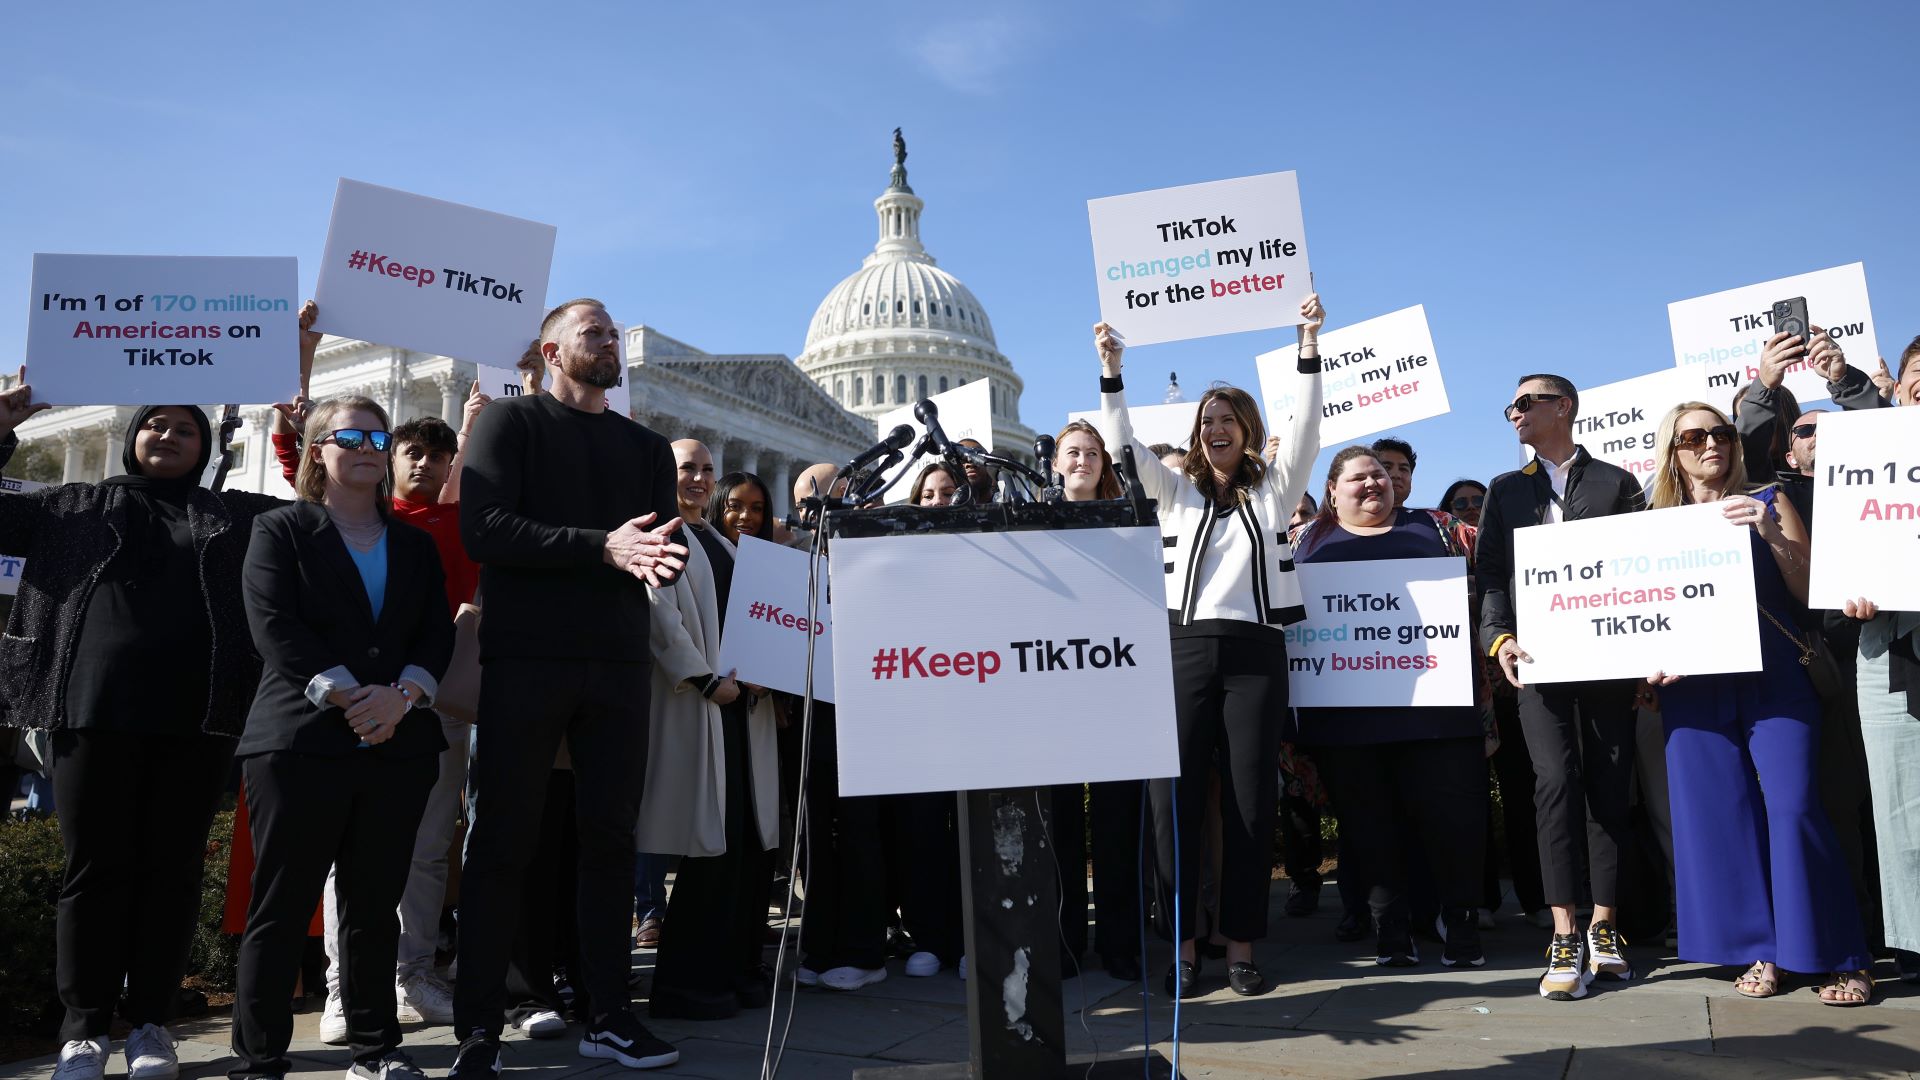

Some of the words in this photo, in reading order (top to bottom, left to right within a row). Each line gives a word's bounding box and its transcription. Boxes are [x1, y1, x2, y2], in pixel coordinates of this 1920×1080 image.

[1157, 215, 1237, 242] TikTok
[1107, 249, 1211, 281] changed
[1217, 247, 1253, 267] my
[1260, 239, 1297, 260] life
[348, 250, 435, 287] #Keep
[443, 268, 524, 303] TikTok
[43, 293, 86, 311] I'm
[94, 295, 106, 311] 1
[114, 294, 144, 311] of
[151, 295, 196, 312] 170
[204, 294, 289, 312] million
[1125, 290, 1160, 309] for
[1165, 284, 1205, 303] the
[1210, 273, 1285, 297] better
[73, 321, 221, 338] Americans
[228, 325, 261, 338] on
[1730, 310, 1774, 332] TikT
[124, 348, 214, 366] TikTok
[1684, 339, 1757, 365] helped
[1274, 372, 1356, 411] chged
[1361, 365, 1391, 383] my
[1396, 355, 1428, 373] life
[1708, 371, 1740, 388] my
[1322, 400, 1353, 417] the
[1357, 380, 1420, 407] better
[1575, 407, 1644, 434] TikTok
[1603, 436, 1637, 454] me
[1828, 464, 1874, 486] I'm
[1884, 462, 1896, 483] 1
[1524, 568, 1557, 585] I'm
[1563, 564, 1573, 581] 1
[1580, 560, 1603, 580] of
[1610, 556, 1650, 576] 170
[1657, 548, 1741, 572] million
[1322, 593, 1401, 613] TikTok
[1550, 586, 1676, 611] Americans
[1682, 583, 1715, 599] on
[1284, 624, 1347, 647] elped
[1354, 625, 1391, 640] me
[1398, 624, 1460, 644] grow
[1591, 613, 1671, 636] TikTok
[872, 647, 1001, 683] #Keep
[1010, 637, 1137, 672] TikTok
[1289, 657, 1325, 676] my
[1331, 650, 1438, 671] business
